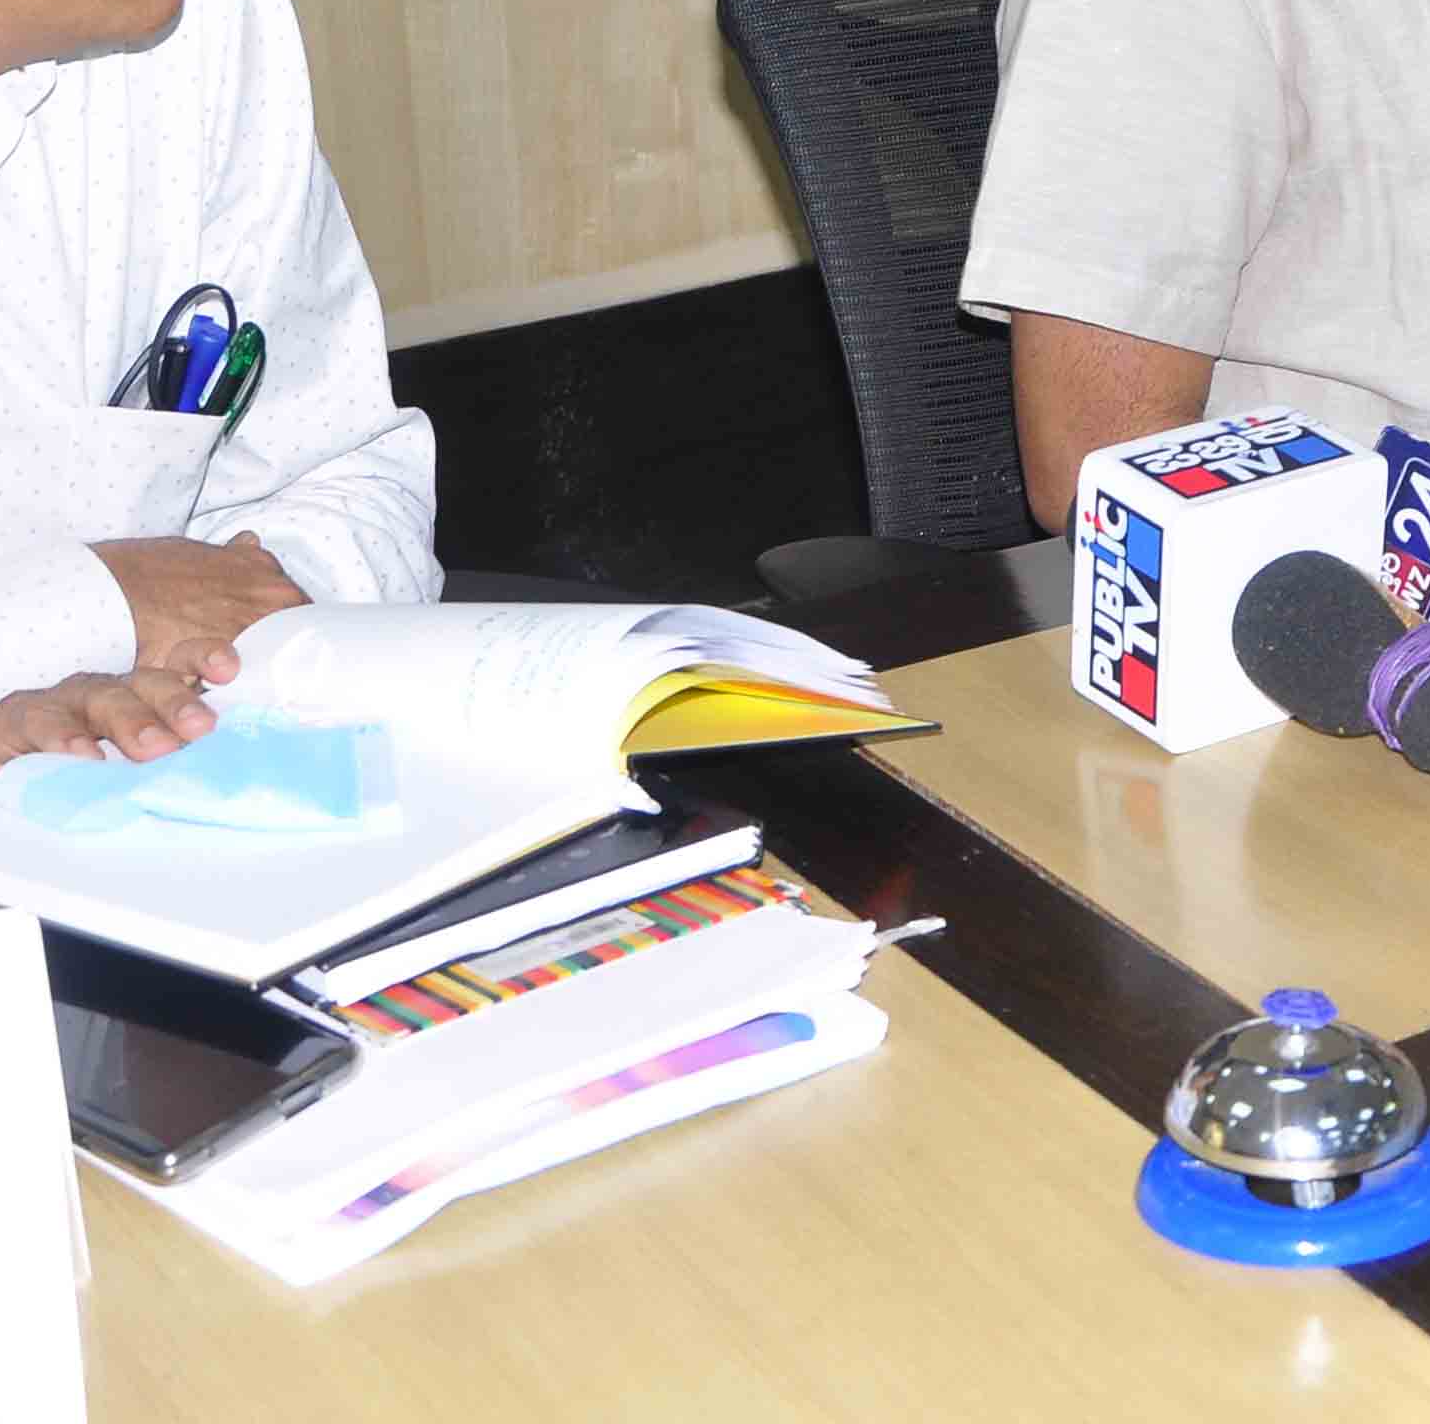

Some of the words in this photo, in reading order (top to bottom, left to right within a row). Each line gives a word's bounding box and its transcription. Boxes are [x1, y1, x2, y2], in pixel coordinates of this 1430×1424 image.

[1202, 446, 1284, 482] TV
[1087, 495, 1129, 696] PUBLIC
[1123, 559, 1160, 657] TV
